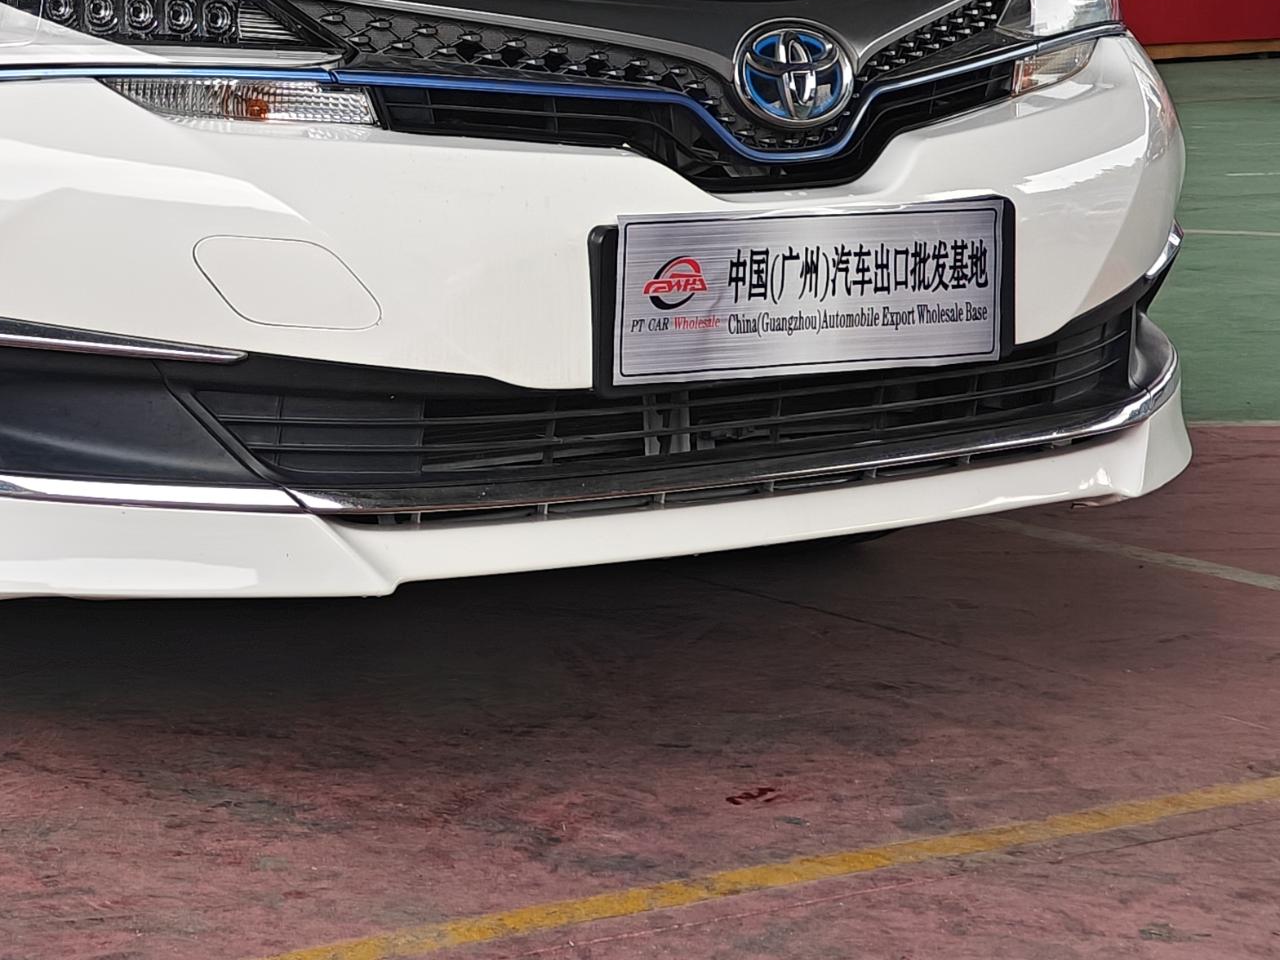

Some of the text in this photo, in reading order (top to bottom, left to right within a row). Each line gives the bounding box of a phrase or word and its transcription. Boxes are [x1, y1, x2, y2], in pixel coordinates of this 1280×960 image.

[728, 239, 988, 304] 中国(广州)汽车出口批发基地
[630, 315, 720, 333] PT CAR Wholesale
[881, 306, 915, 330] Export
[917, 302, 963, 324] Wholesale
[965, 302, 988, 321] Base
